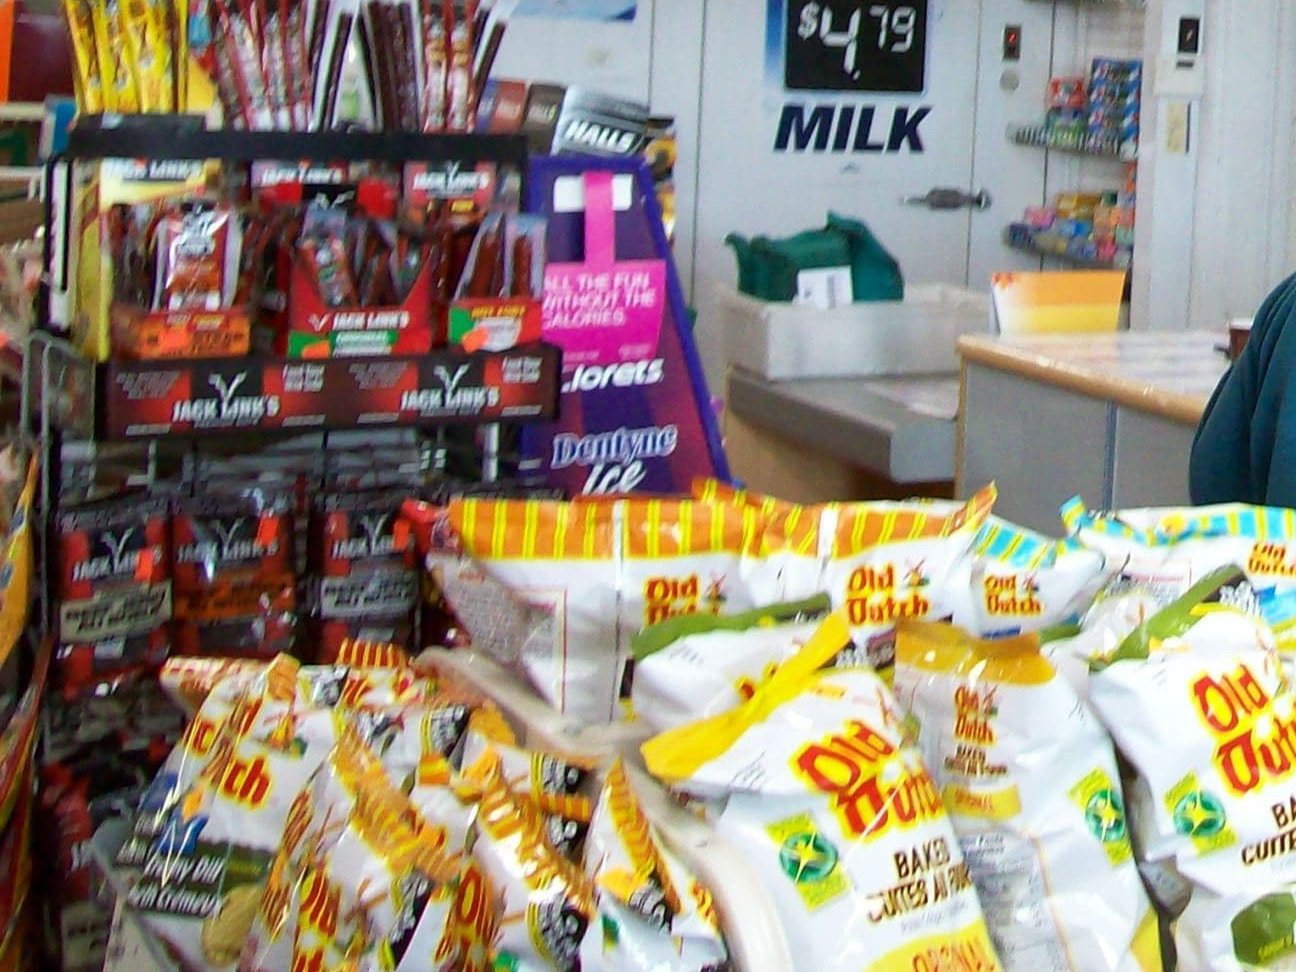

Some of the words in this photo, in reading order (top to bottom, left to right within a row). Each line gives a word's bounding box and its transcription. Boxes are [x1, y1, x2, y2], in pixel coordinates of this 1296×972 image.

[773, 104, 934, 154] MILK
[172, 397, 219, 423] JACK
[219, 393, 281, 421] LINK'S
[401, 391, 443, 412] JACK
[551, 424, 678, 469] Dentyne
[582, 459, 647, 495] Ice
[646, 573, 698, 601] Old
[848, 564, 896, 593] Old
[847, 594, 930, 626] Dutch
[1192, 662, 1270, 734] Old
[796, 719, 896, 794] Old
